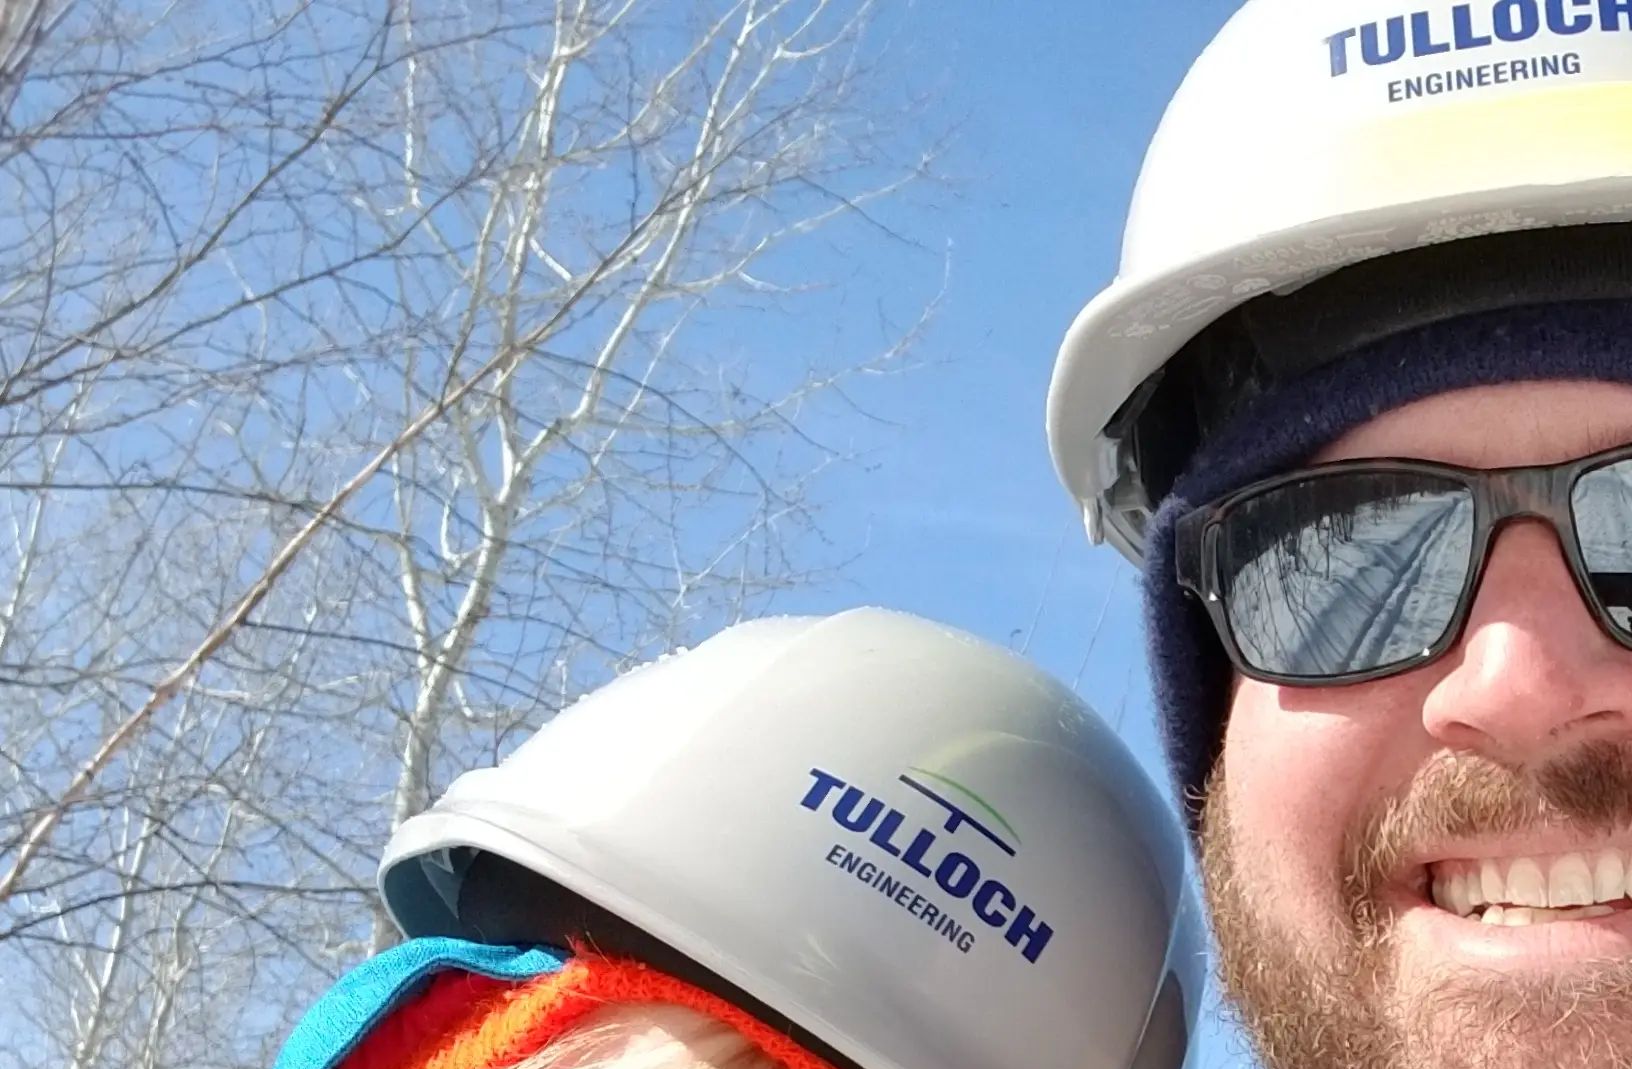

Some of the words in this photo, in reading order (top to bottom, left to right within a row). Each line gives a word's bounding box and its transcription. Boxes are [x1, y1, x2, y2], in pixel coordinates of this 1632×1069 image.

[1387, 52, 1581, 102] ENGINEERING
[800, 768, 1054, 964] TULLOCH
[825, 844, 976, 953] ENGINEERING
